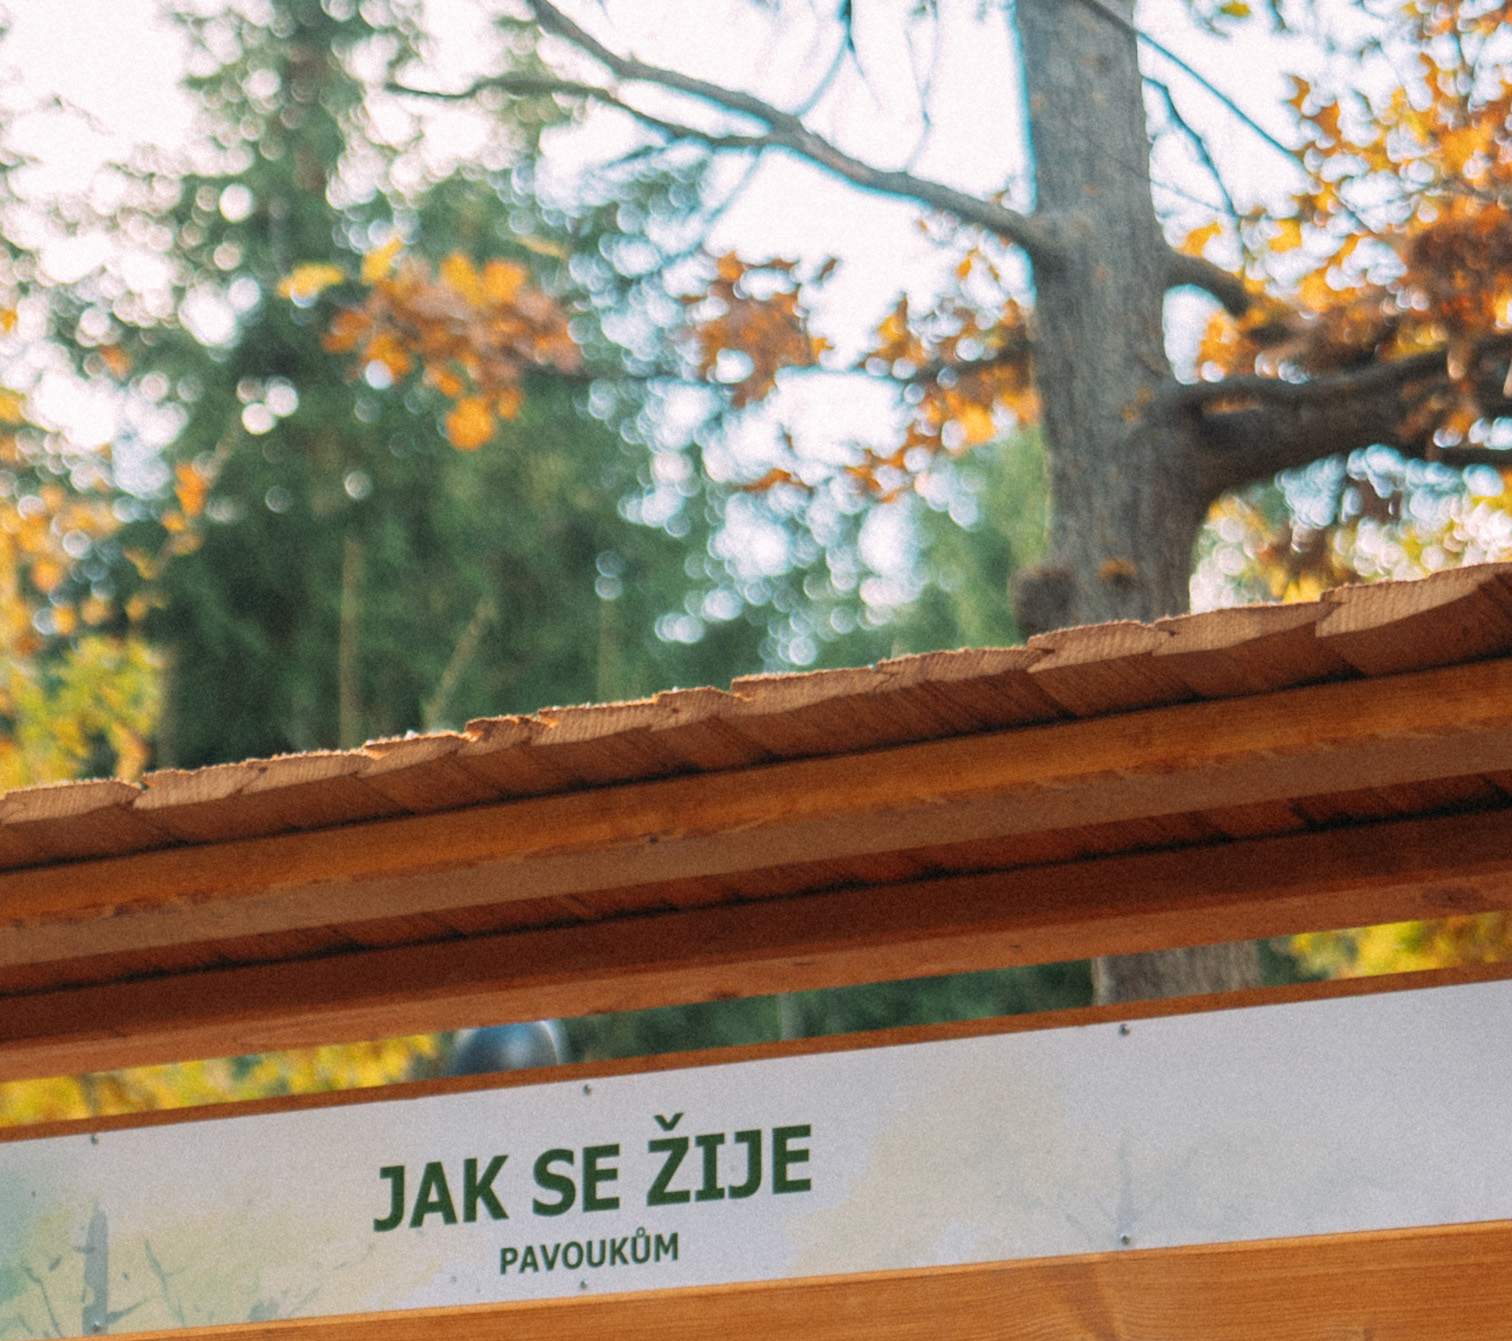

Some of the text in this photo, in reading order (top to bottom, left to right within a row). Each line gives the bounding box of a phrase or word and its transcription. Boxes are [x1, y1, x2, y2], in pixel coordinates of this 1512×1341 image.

[373, 1112, 812, 1232] JAK SE ŽIJE
[500, 1227, 679, 1275] PAVOUKŮM
